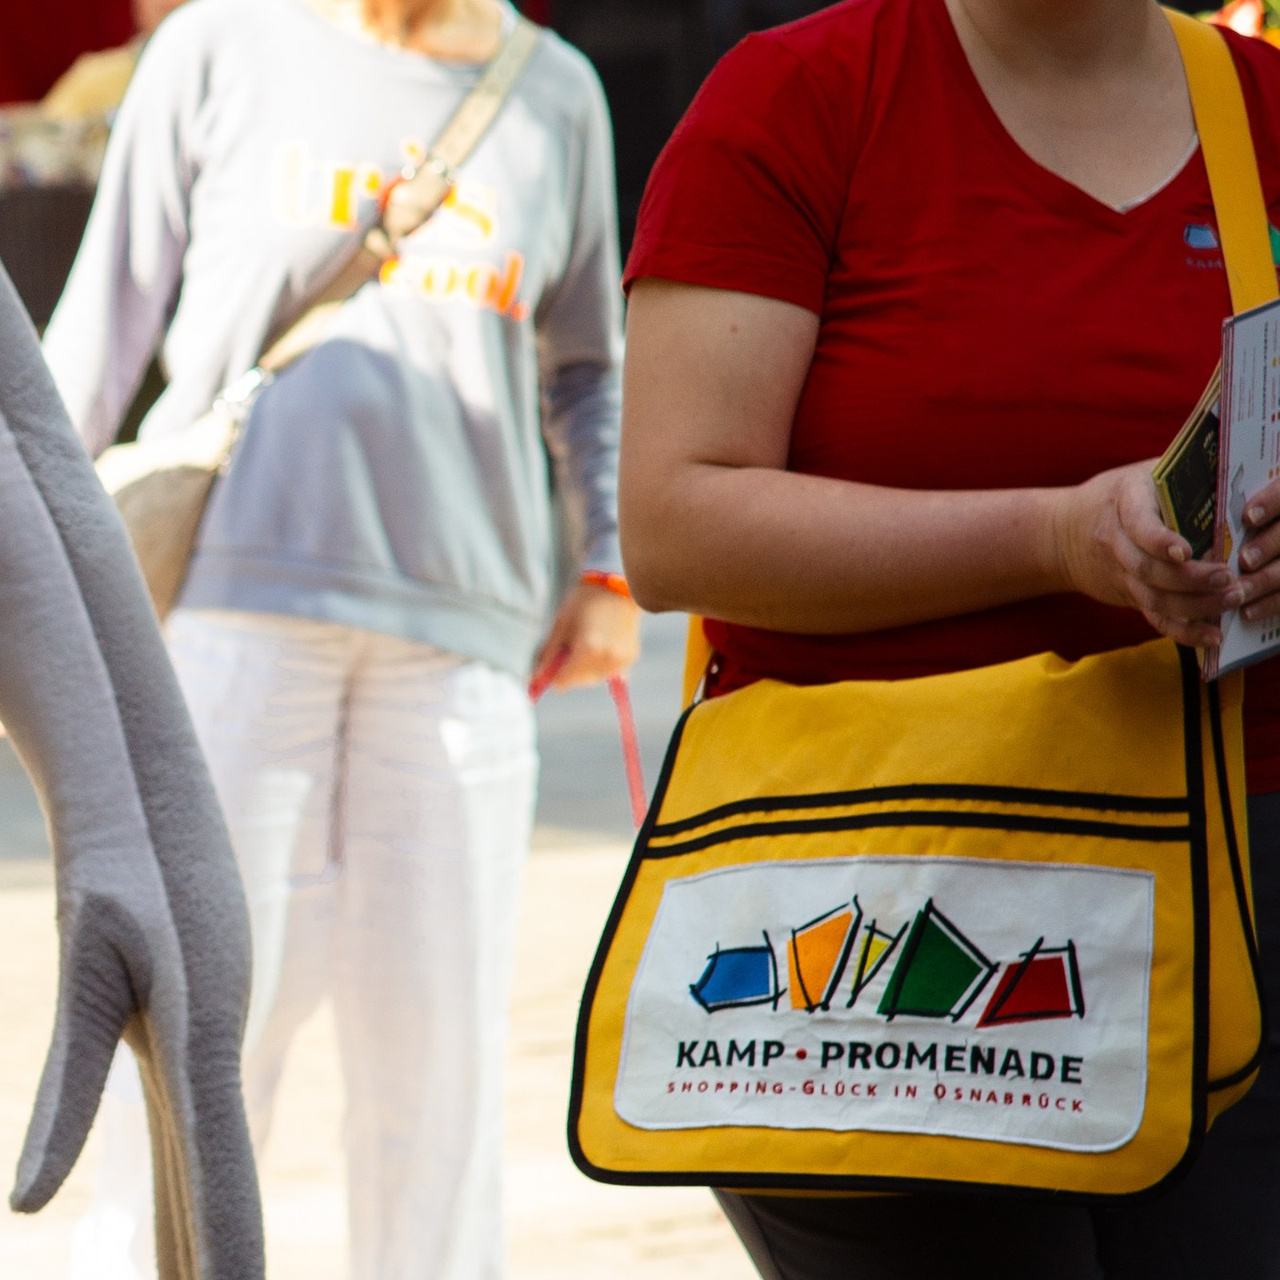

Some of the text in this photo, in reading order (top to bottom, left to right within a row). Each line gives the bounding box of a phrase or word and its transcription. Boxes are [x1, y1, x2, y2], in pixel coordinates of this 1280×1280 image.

[676, 1039, 1084, 1084] KAMP PROMENADE
[666, 1078, 1084, 1113] SHOPPING-GLÜCK IN OSNABRÜCK
